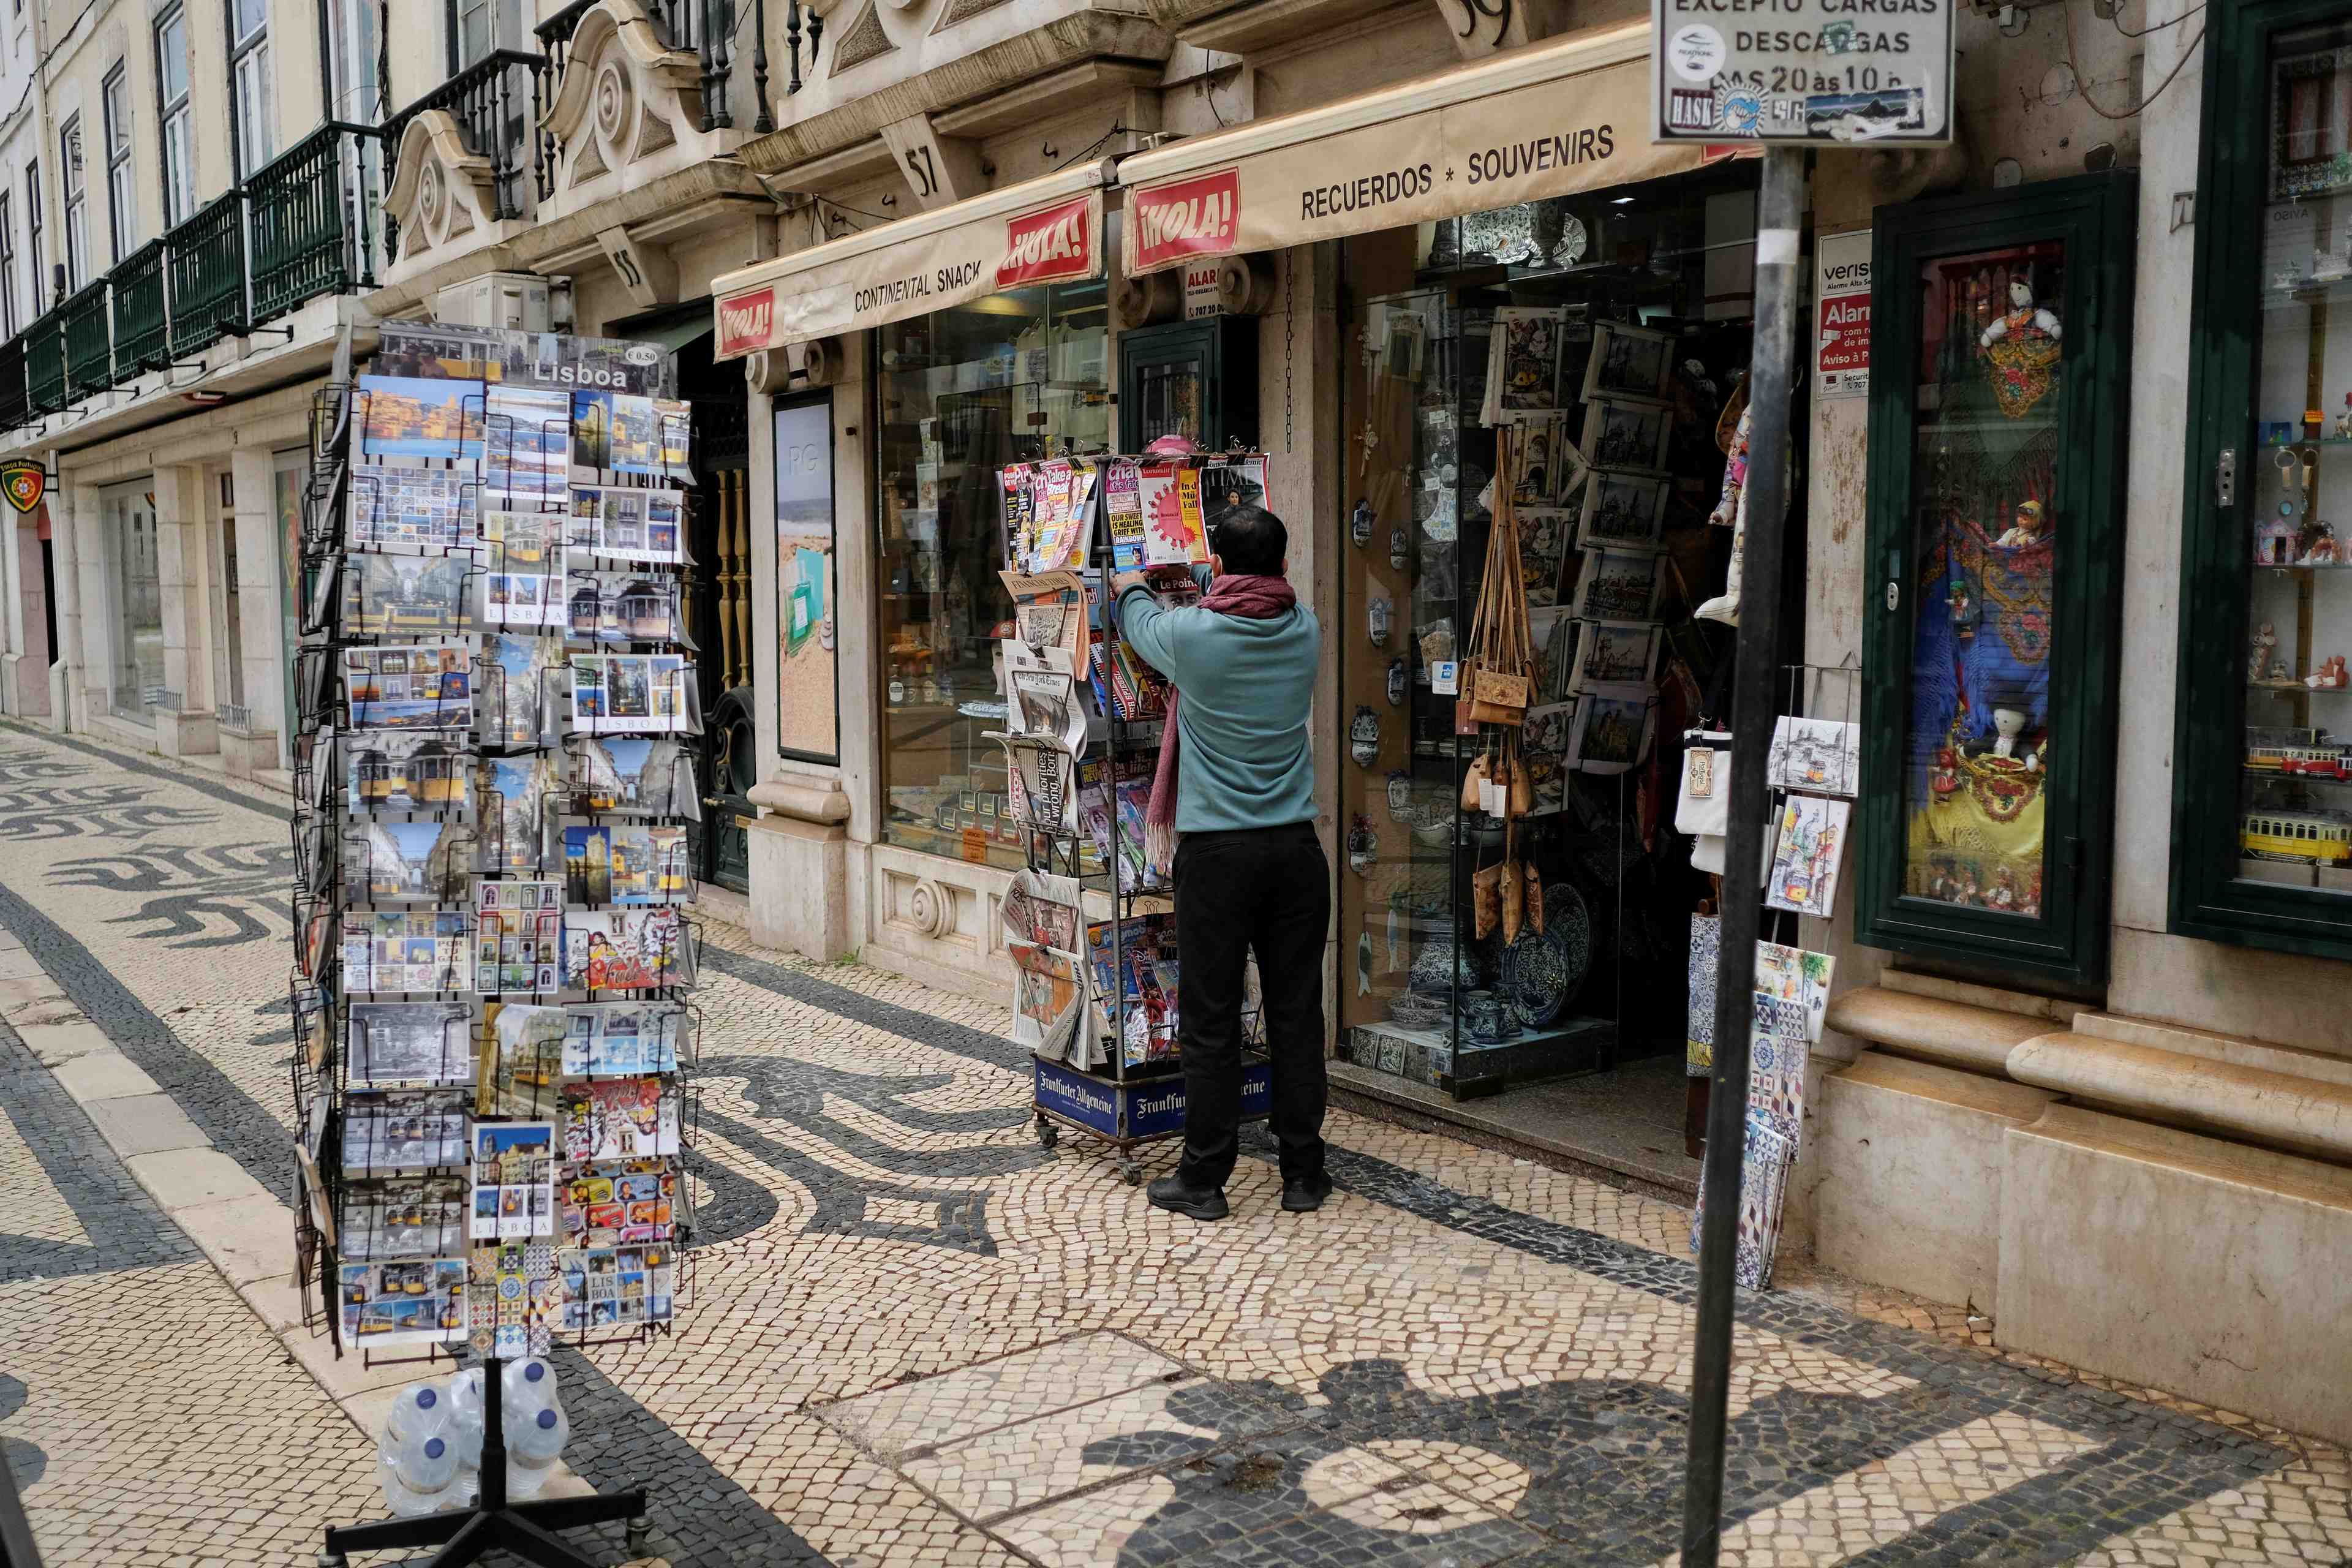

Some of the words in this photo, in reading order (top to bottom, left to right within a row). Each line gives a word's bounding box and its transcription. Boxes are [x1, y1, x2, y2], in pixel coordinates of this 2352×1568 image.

[1736, 31, 1910, 53] DESCAGAS
[1771, 66, 1807, 92] 20
[1814, 70, 1840, 91] às
[1845, 66, 1878, 91] 10
[1302, 164, 1432, 221] RECUERDOS
[1468, 124, 1615, 184] SOUVENIRS
[1188, 268, 1221, 288] ALAR
[855, 274, 931, 313] CONTINENTAL
[937, 260, 982, 293] SNACK
[1828, 281, 1848, 290] Alarme
[1196, 306, 1207, 316] 707
[1844, 338, 1855, 347] de
[636, 352, 655, 361] 0.50
[1823, 354, 1850, 366] Aviso
[1852, 351, 1859, 363] à
[535, 359, 627, 387] Lisboa
[1047, 470, 1066, 483] Take
[1066, 469, 1071, 480] a
[1210, 467, 1256, 486] TIME
[1047, 481, 1069, 494] Break
[1110, 481, 1123, 491] it's
[1119, 520, 1143, 529] HEALING
[1114, 535, 1145, 544] RAINBOWS
[1012, 578, 1049, 589] FINANCIAL
[1160, 581, 1171, 589] Le
[489, 608, 563, 620] LSBOA
[1026, 673, 1035, 681] New
[1035, 674, 1046, 685] York
[1046, 675, 1061, 686] Times
[1038, 752, 1050, 803] priorities
[1049, 780, 1061, 818] wrong,
[1041, 1070, 1076, 1100] Frankfurter
[1076, 1085, 1112, 1115] Allgemeine
[592, 1276, 613, 1287] LIS
[592, 1288, 614, 1299] BOA
